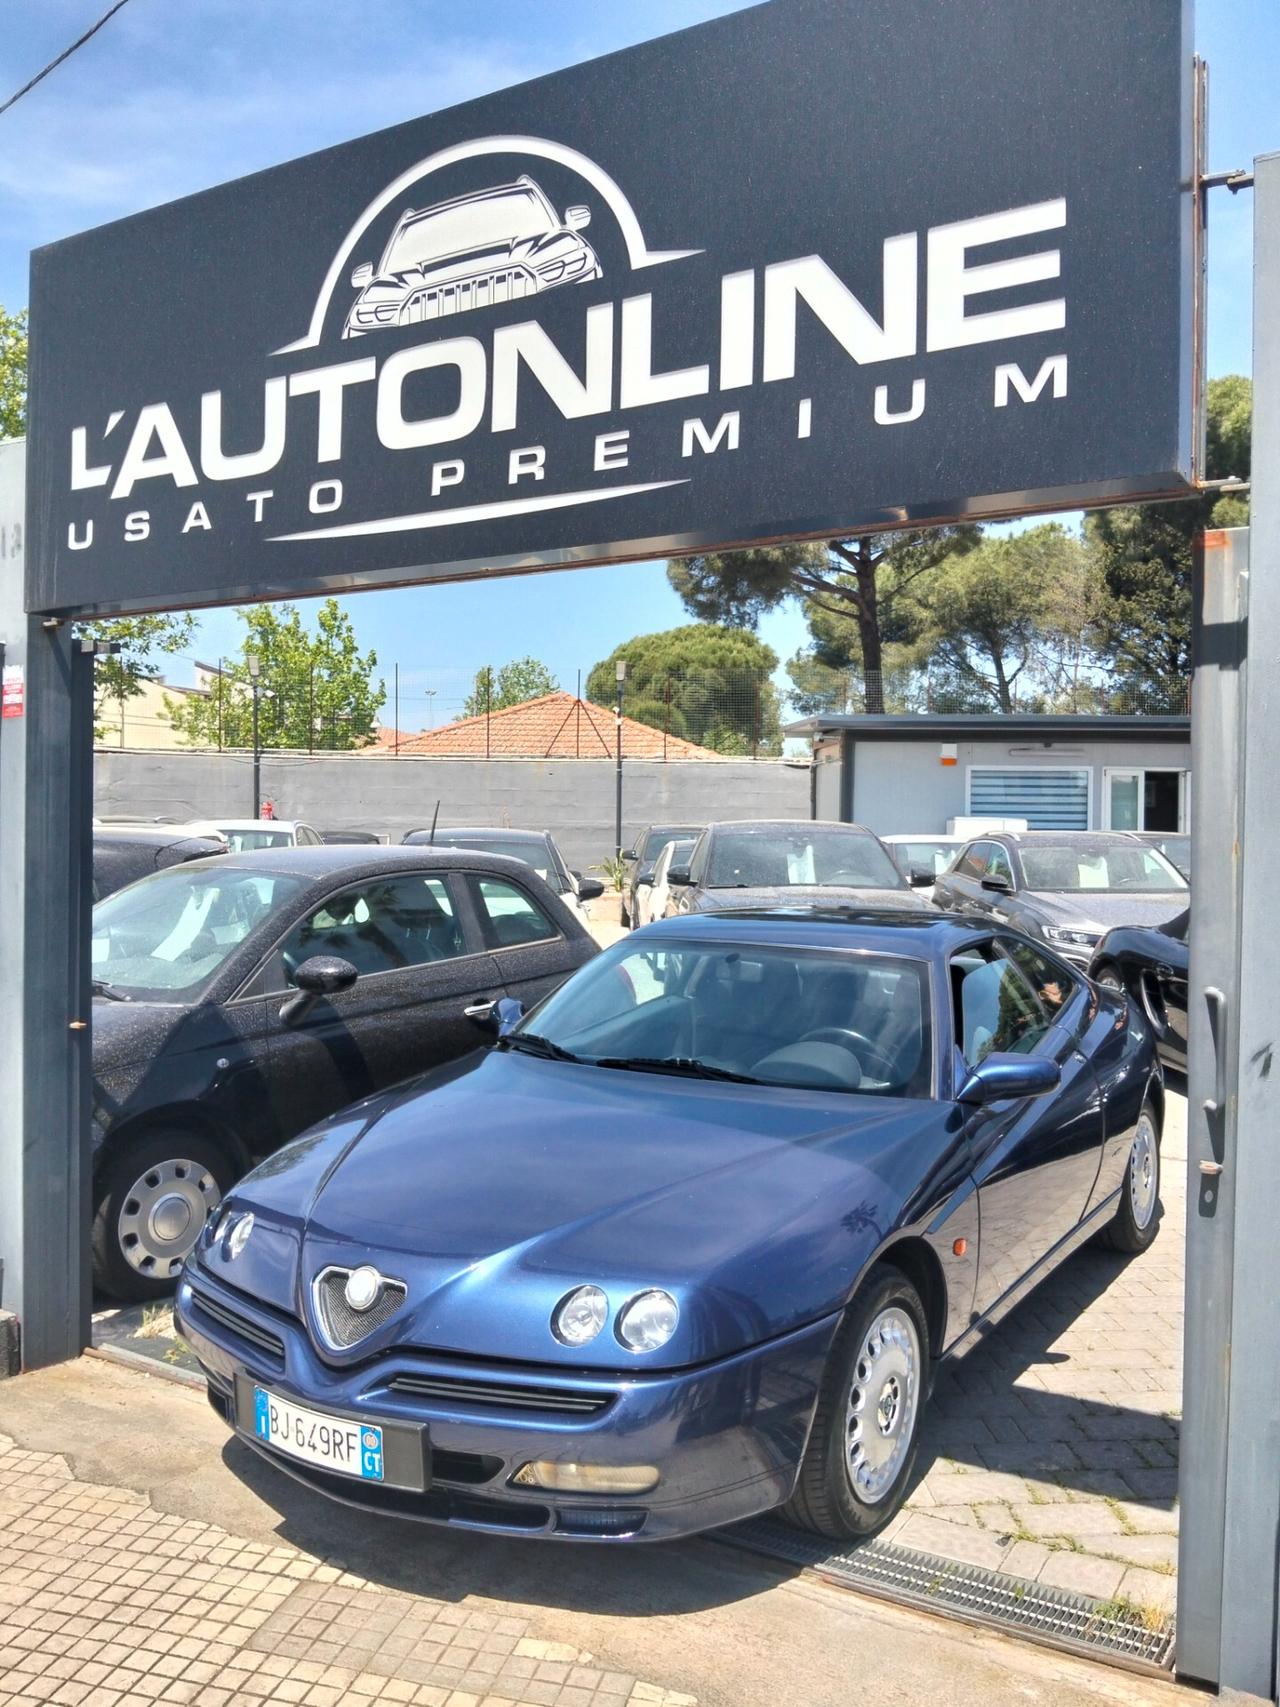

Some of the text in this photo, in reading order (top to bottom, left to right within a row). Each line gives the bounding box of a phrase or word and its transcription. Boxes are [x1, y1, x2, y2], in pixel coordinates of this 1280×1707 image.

[70, 197, 1067, 500] L'AUTONLINE
[67, 354, 1069, 551] USATO PREMIUM
[364, 1451, 381, 1473] CT
